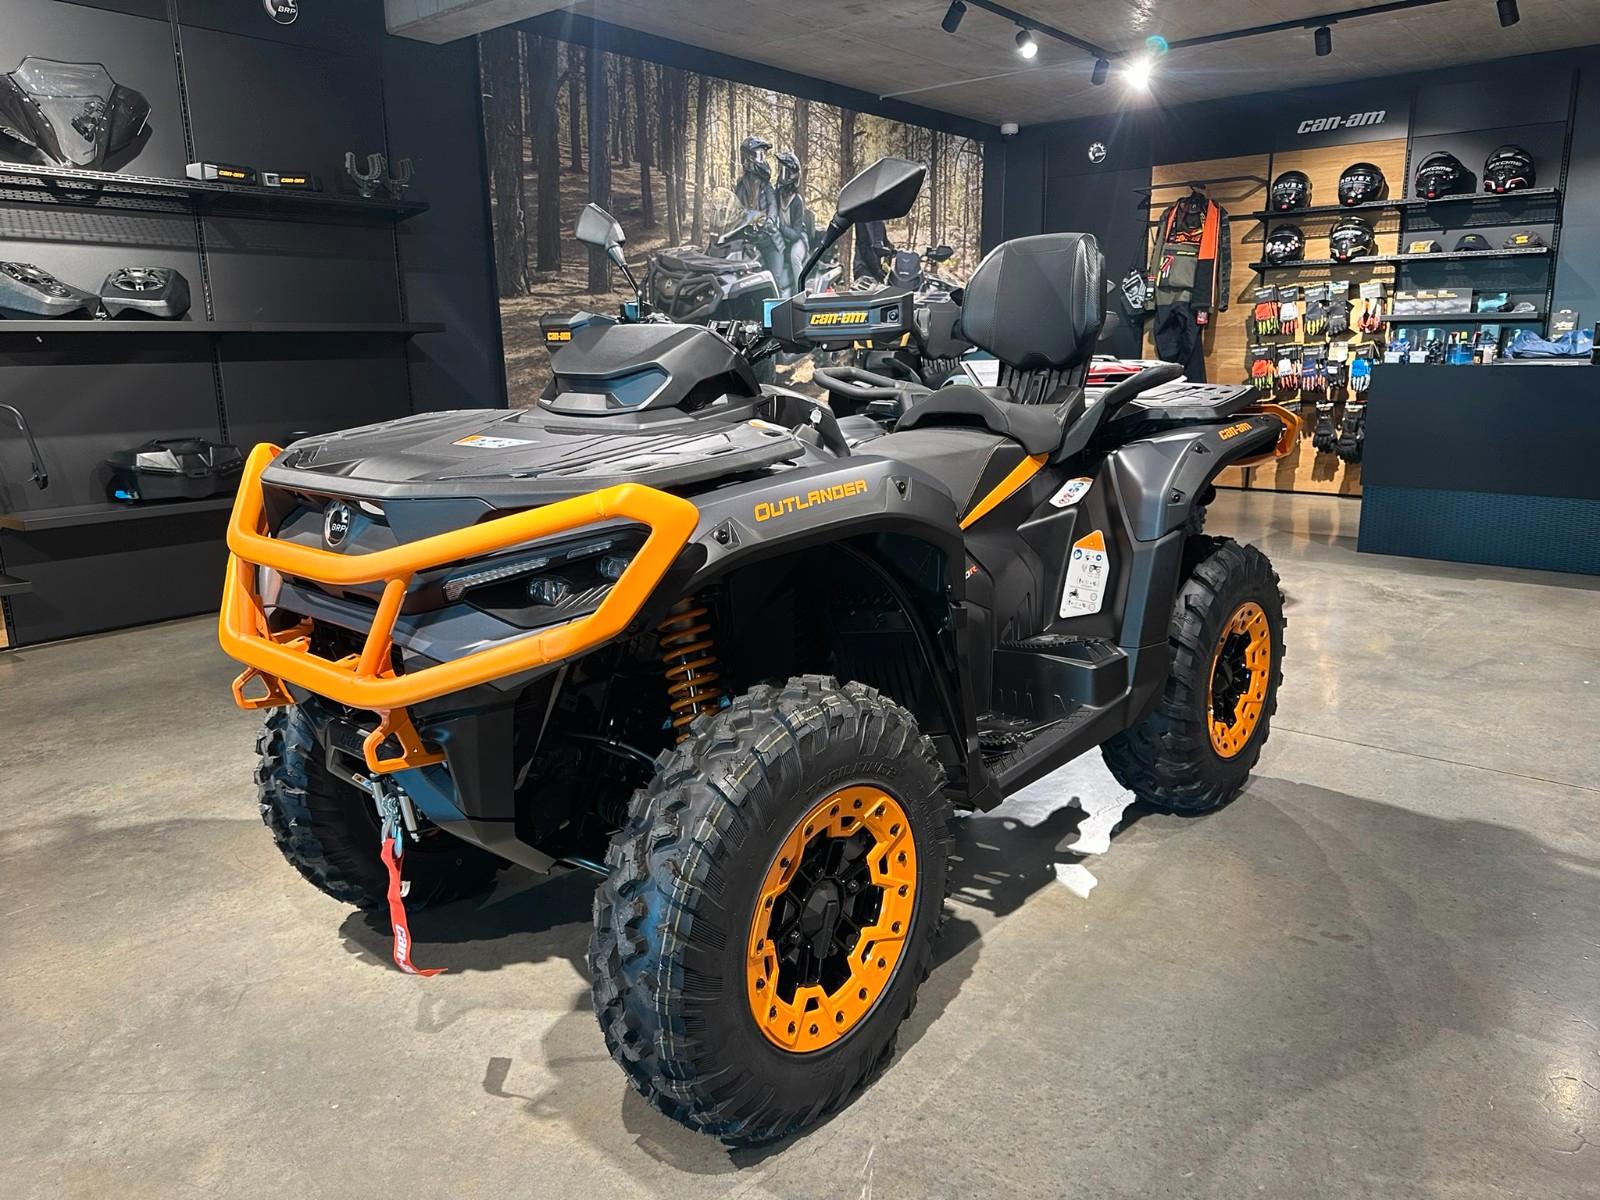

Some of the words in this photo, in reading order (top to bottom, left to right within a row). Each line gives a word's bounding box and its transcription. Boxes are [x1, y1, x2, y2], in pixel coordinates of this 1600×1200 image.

[278, 5, 296, 14] BRP
[1297, 110, 1386, 134] can-am
[810, 312, 869, 325] can-am
[1218, 422, 1253, 441] can-am
[754, 479, 868, 522] OUTLANDER
[331, 523, 347, 532] BRP
